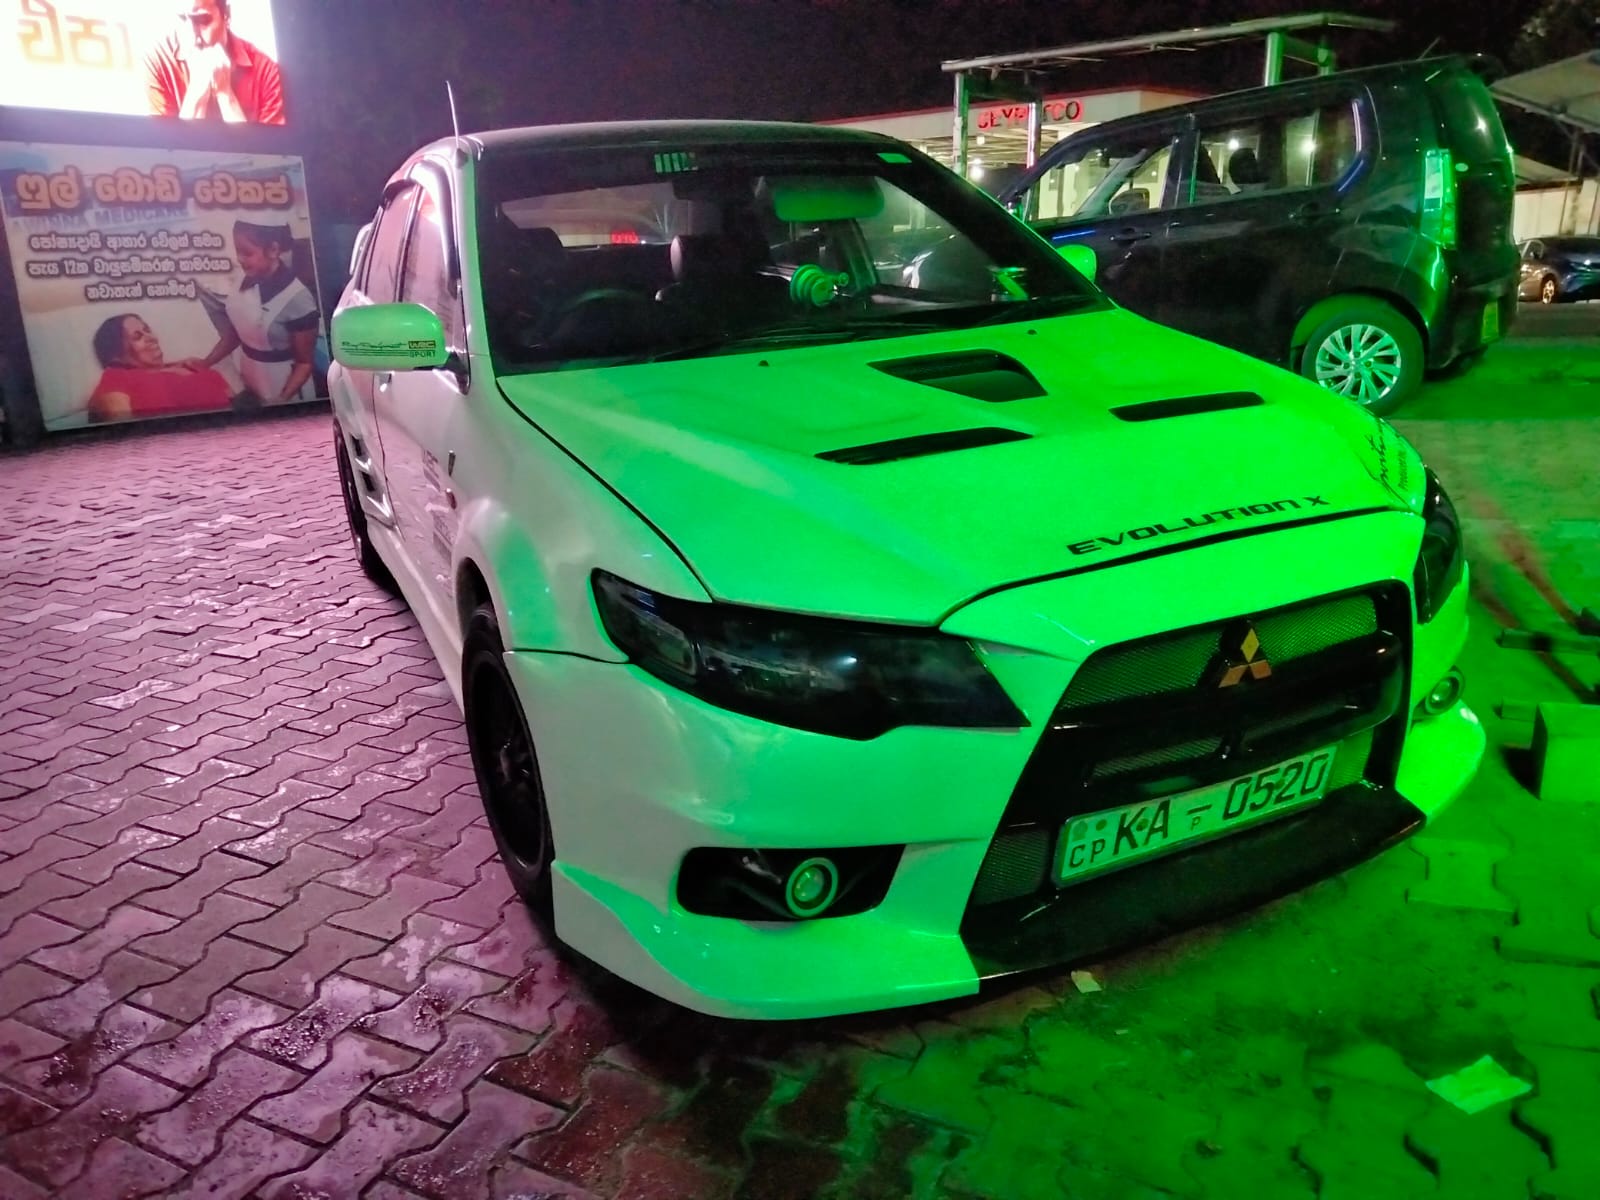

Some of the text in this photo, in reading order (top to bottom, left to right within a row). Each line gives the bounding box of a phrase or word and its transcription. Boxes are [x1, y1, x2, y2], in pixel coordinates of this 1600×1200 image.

[15, 165, 82, 210] ෆුල්
[409, 350, 436, 358] SPORT
[1066, 495, 1331, 556] EVOLUTION X
[1222, 752, 1330, 821] 0520
[1068, 838, 1106, 869] CP
